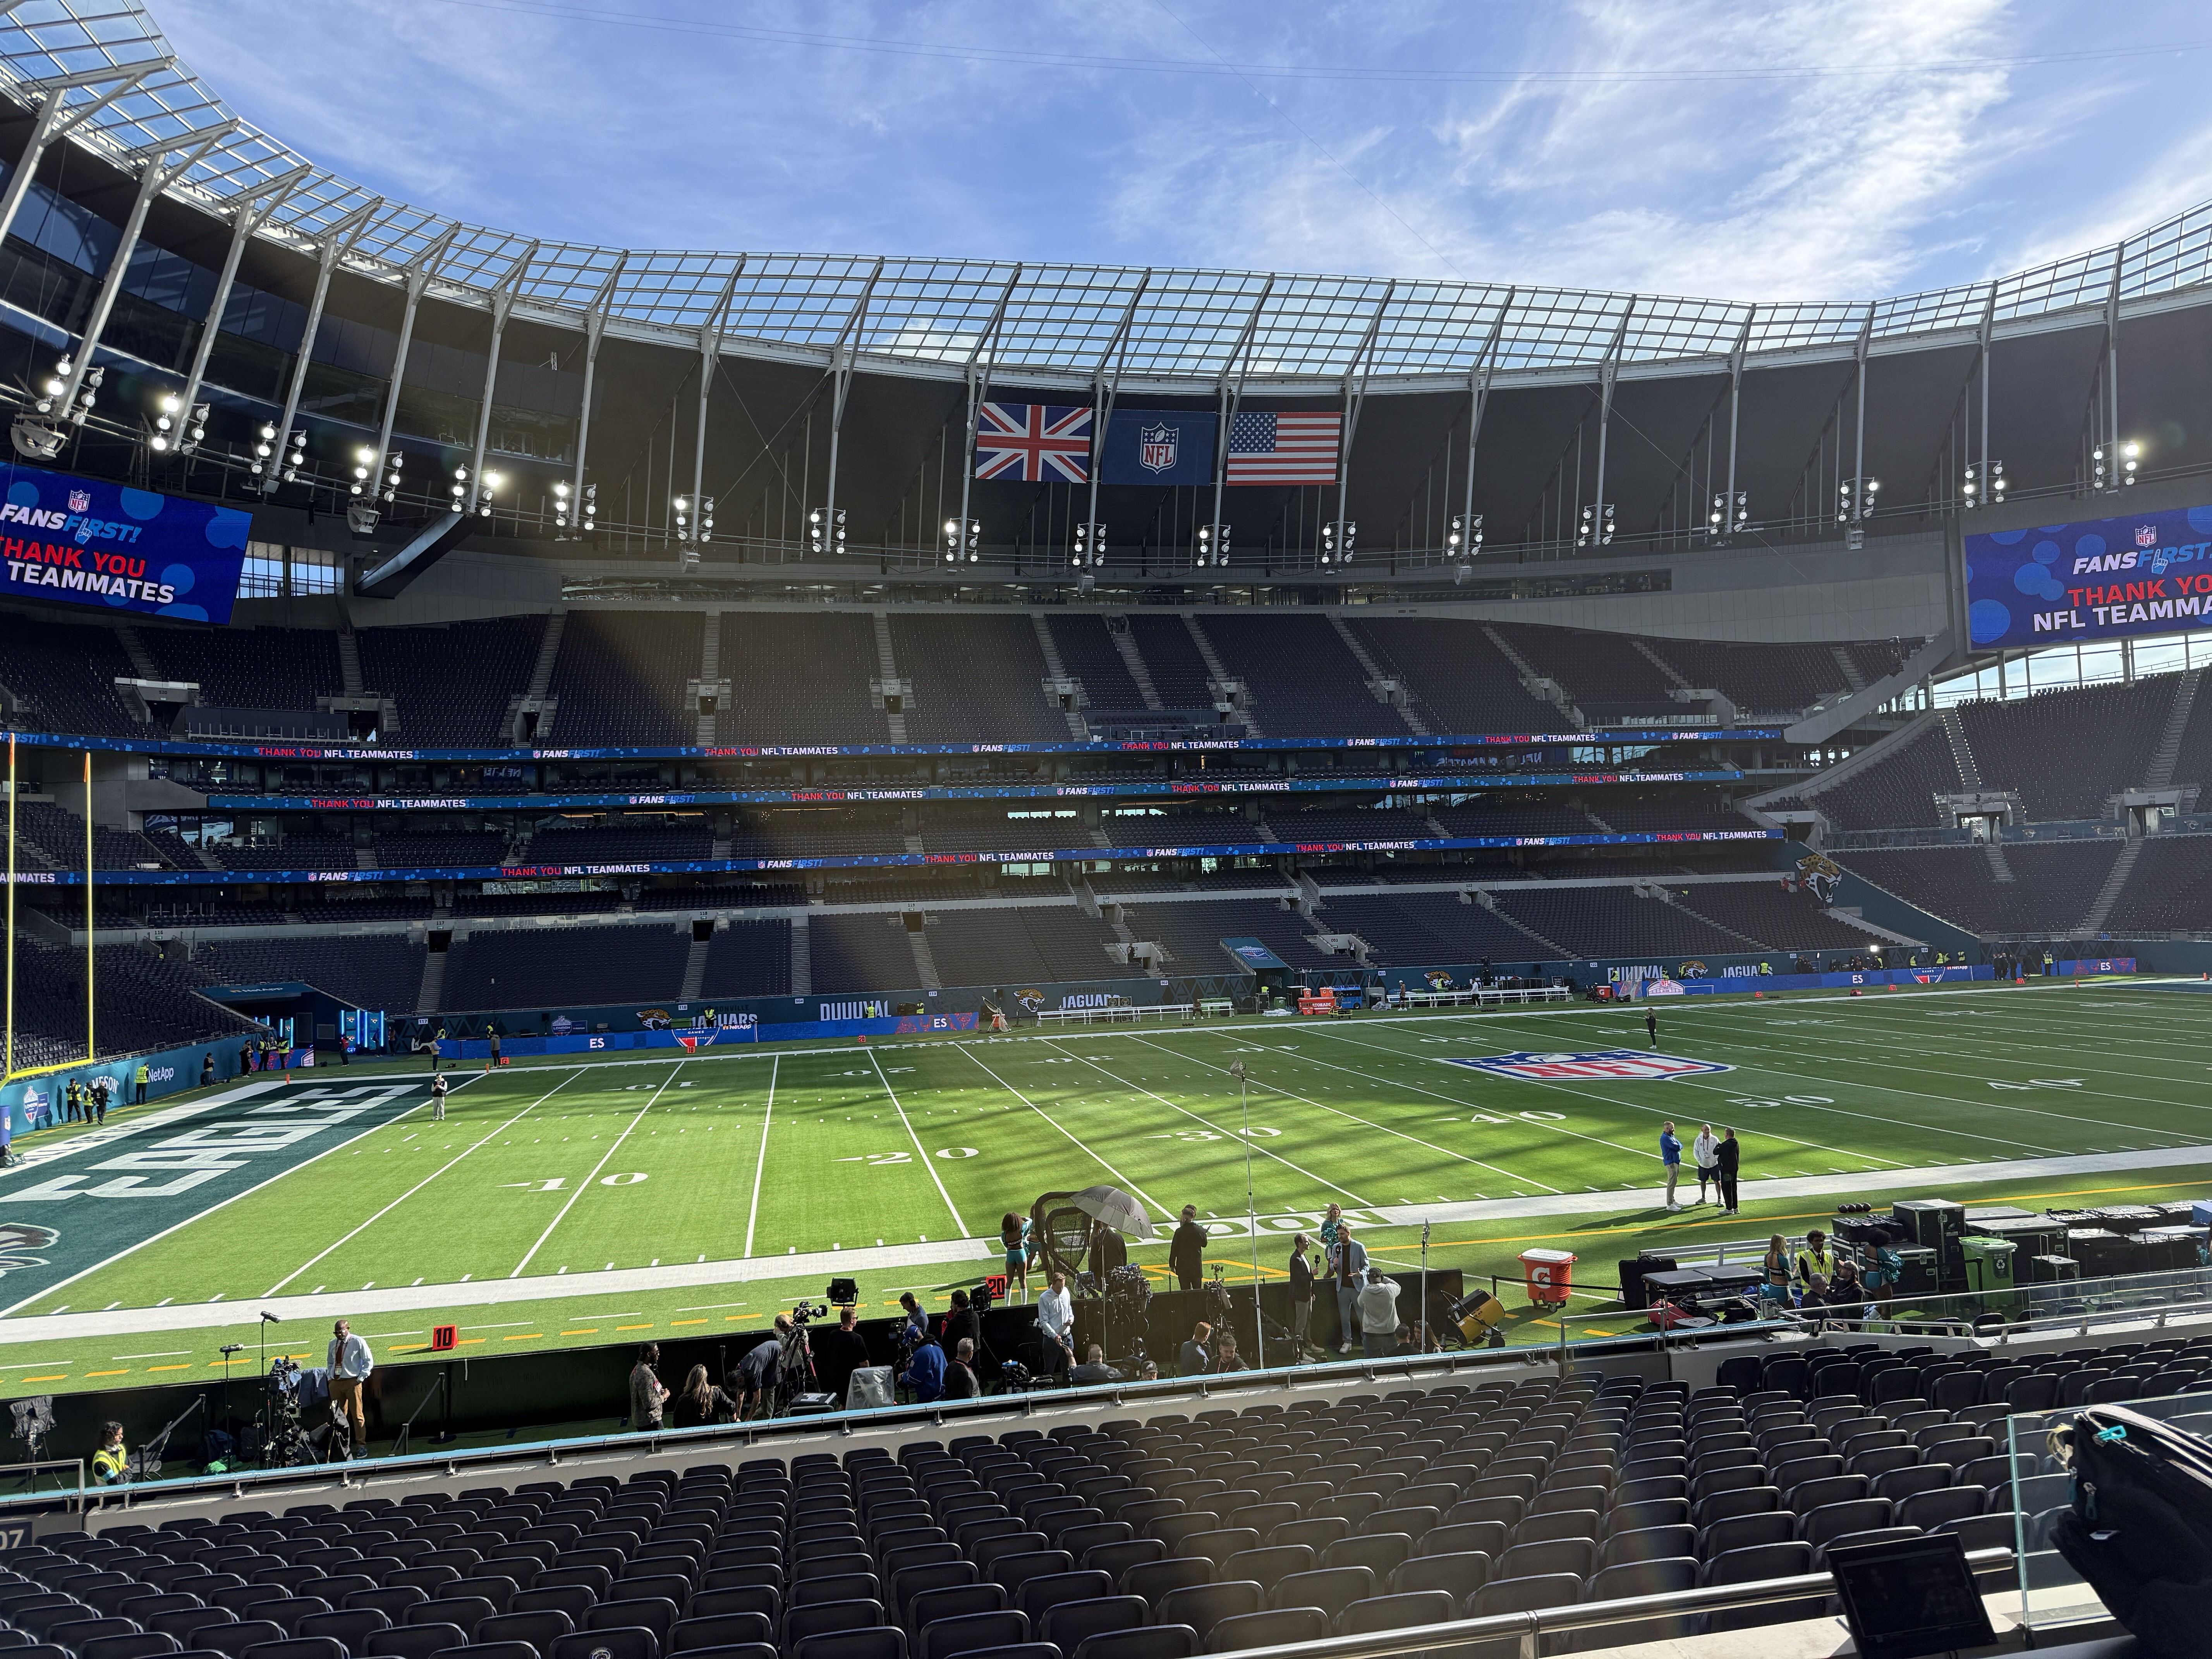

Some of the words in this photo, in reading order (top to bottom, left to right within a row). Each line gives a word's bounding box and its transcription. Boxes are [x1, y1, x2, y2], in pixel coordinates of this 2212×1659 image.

[1144, 444, 1172, 464] NFL
[71, 500, 86, 510] NFL
[2138, 534, 2154, 544] NFL
[94, 552, 146, 577] YOU
[8, 560, 175, 604] TEAMMATES
[2068, 579, 2167, 607] THANK
[2033, 610, 2086, 632] NFL
[258, 747, 296, 757] THANK
[300, 749, 321, 757] YOU
[324, 749, 344, 758] NFL
[347, 750, 413, 759] TEAMMATES
[1636, 773, 1683, 781] TEAMMATES
[311, 799, 349, 808] THANK
[352, 799, 374, 807] YOU
[400, 799, 466, 807] TEAMMATES
[1364, 841, 1415, 850] TEAMMATES
[924, 855, 955, 863] THANK
[958, 854, 976, 862] YOU
[979, 853, 996, 861] NFL
[999, 852, 1054, 860] TEAMMATES
[501, 868, 536, 876] THANK
[564, 866, 584, 874] NFL
[586, 864, 650, 873] TEAMMATES
[2100, 962, 2111, 970] ES
[1853, 975, 1863, 984] ES
[934, 1018, 947, 1028] ES
[590, 1038, 605, 1048] ES
[148, 1066, 173, 1082] NetApp
[1499, 1058, 1712, 1078] NFL
[1470, 1111, 1566, 1124] 40
[1174, 1126, 1282, 1142] 30
[0, 1084, 424, 1202] EAGLES
[866, 1147, 979, 1167] 20
[527, 1172, 649, 1192] 10
[988, 1278, 1005, 1297] 20
[436, 1328, 452, 1347] 10
